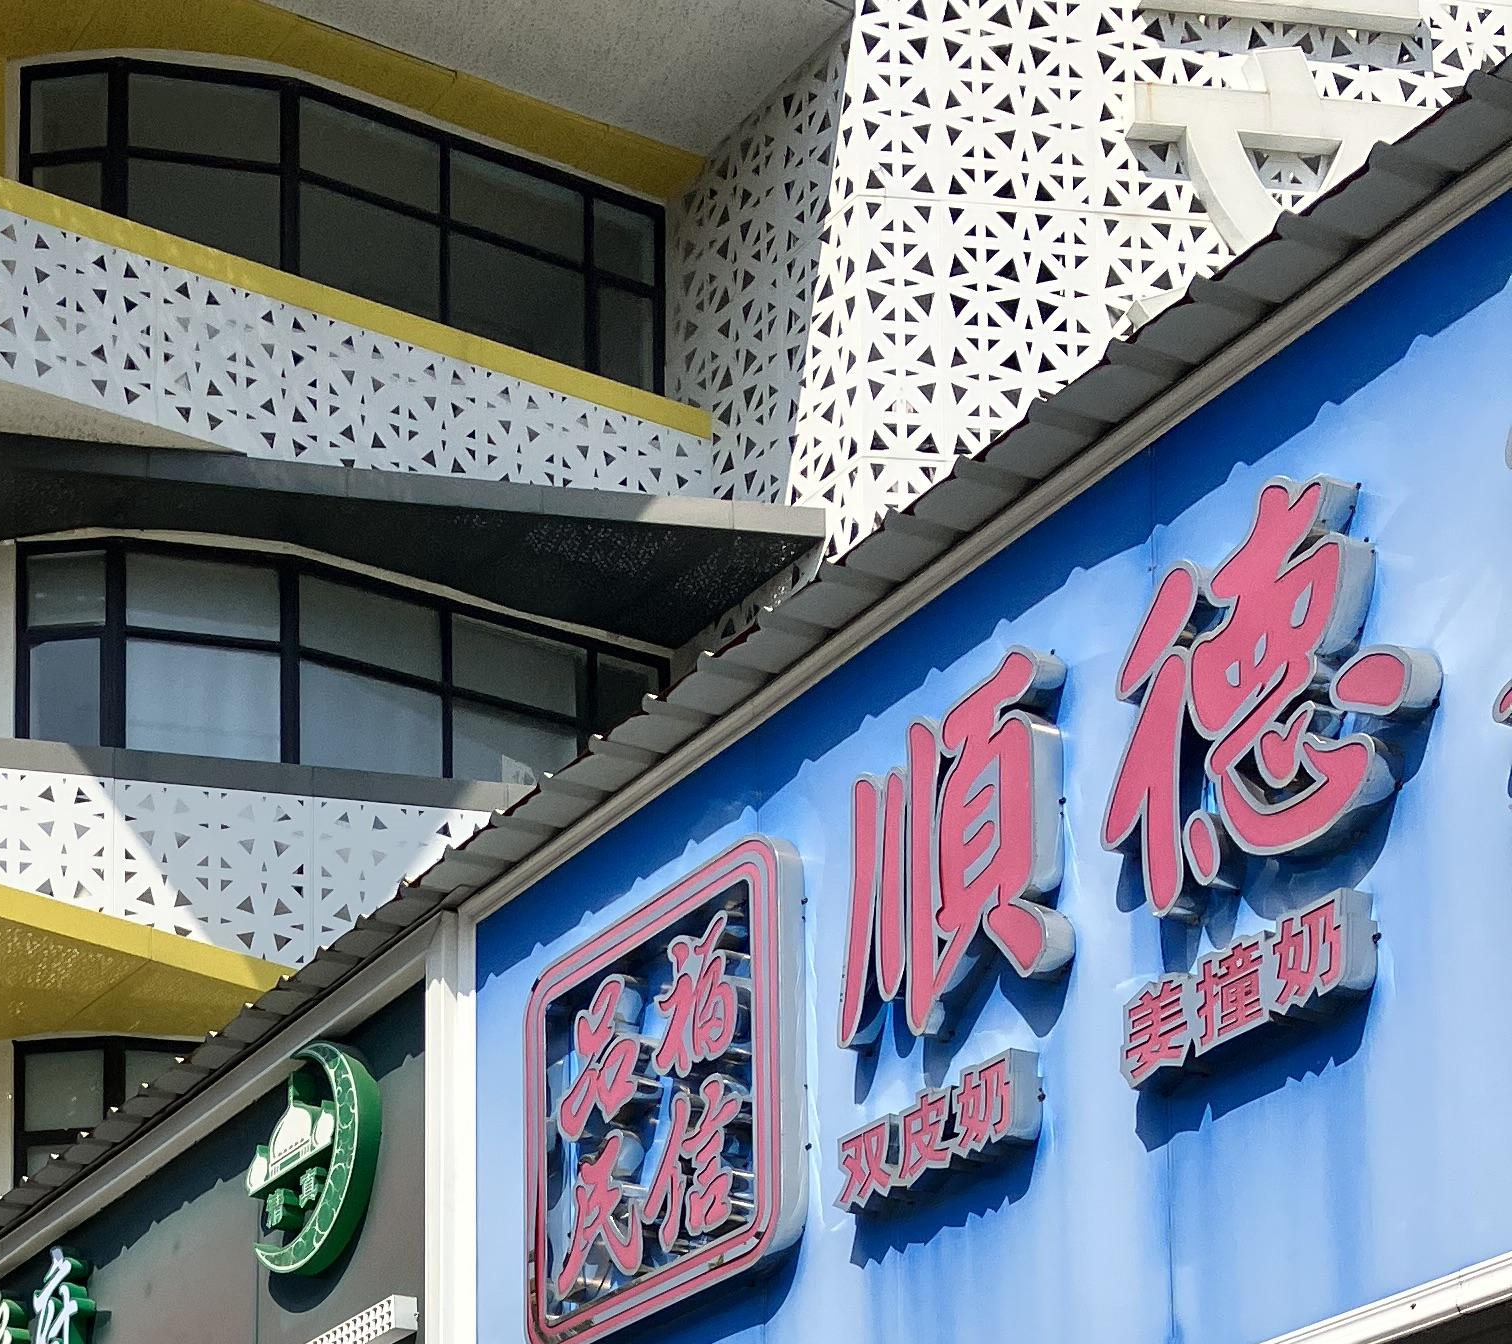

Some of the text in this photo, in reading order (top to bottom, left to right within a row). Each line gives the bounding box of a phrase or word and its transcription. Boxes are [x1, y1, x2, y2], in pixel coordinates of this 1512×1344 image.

[837, 440, 1512, 1049] 順德
[1121, 895, 1346, 1087] 姜撞奶
[265, 1166, 326, 1230] 清真
[836, 1051, 1016, 1210] 双皮奶
